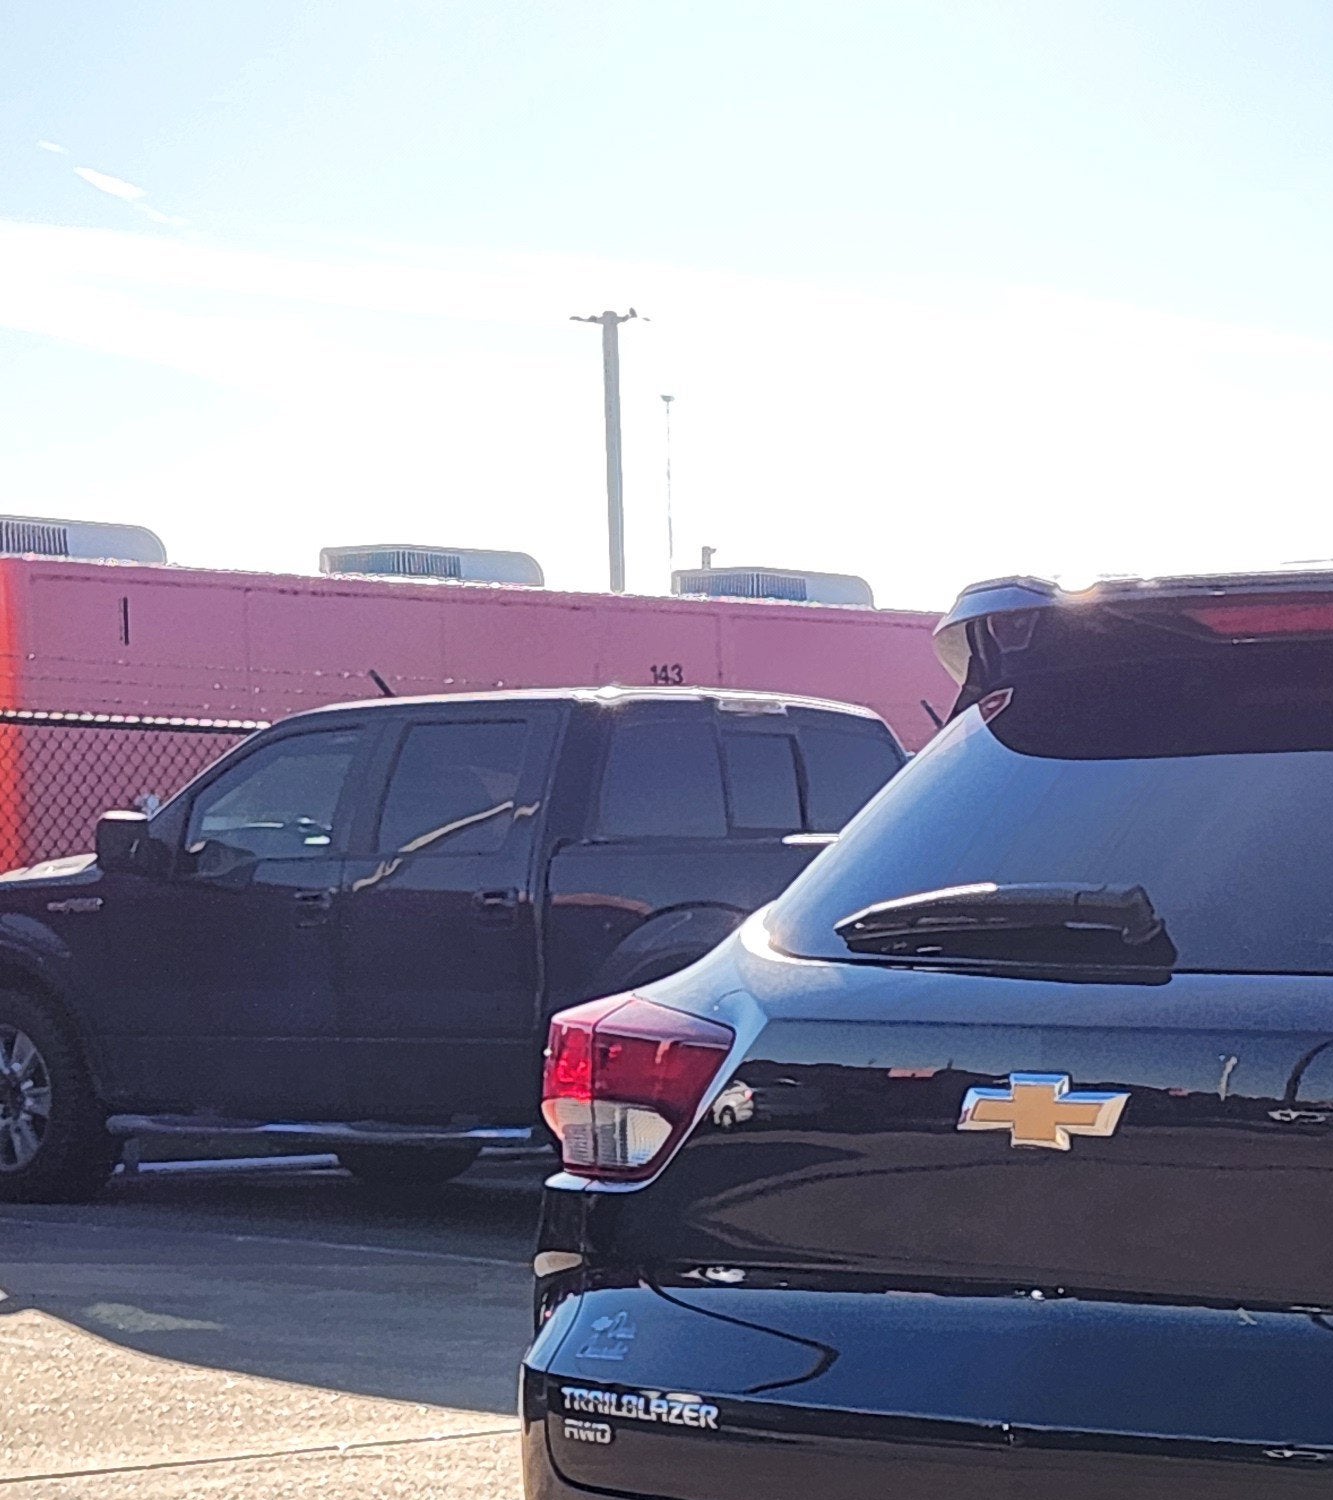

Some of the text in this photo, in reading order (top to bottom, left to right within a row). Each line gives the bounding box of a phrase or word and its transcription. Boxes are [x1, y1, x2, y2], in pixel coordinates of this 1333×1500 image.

[651, 664, 683, 685] 143
[561, 1387, 718, 1429] TRAILBLAZER
[564, 1419, 611, 1444] AWD
